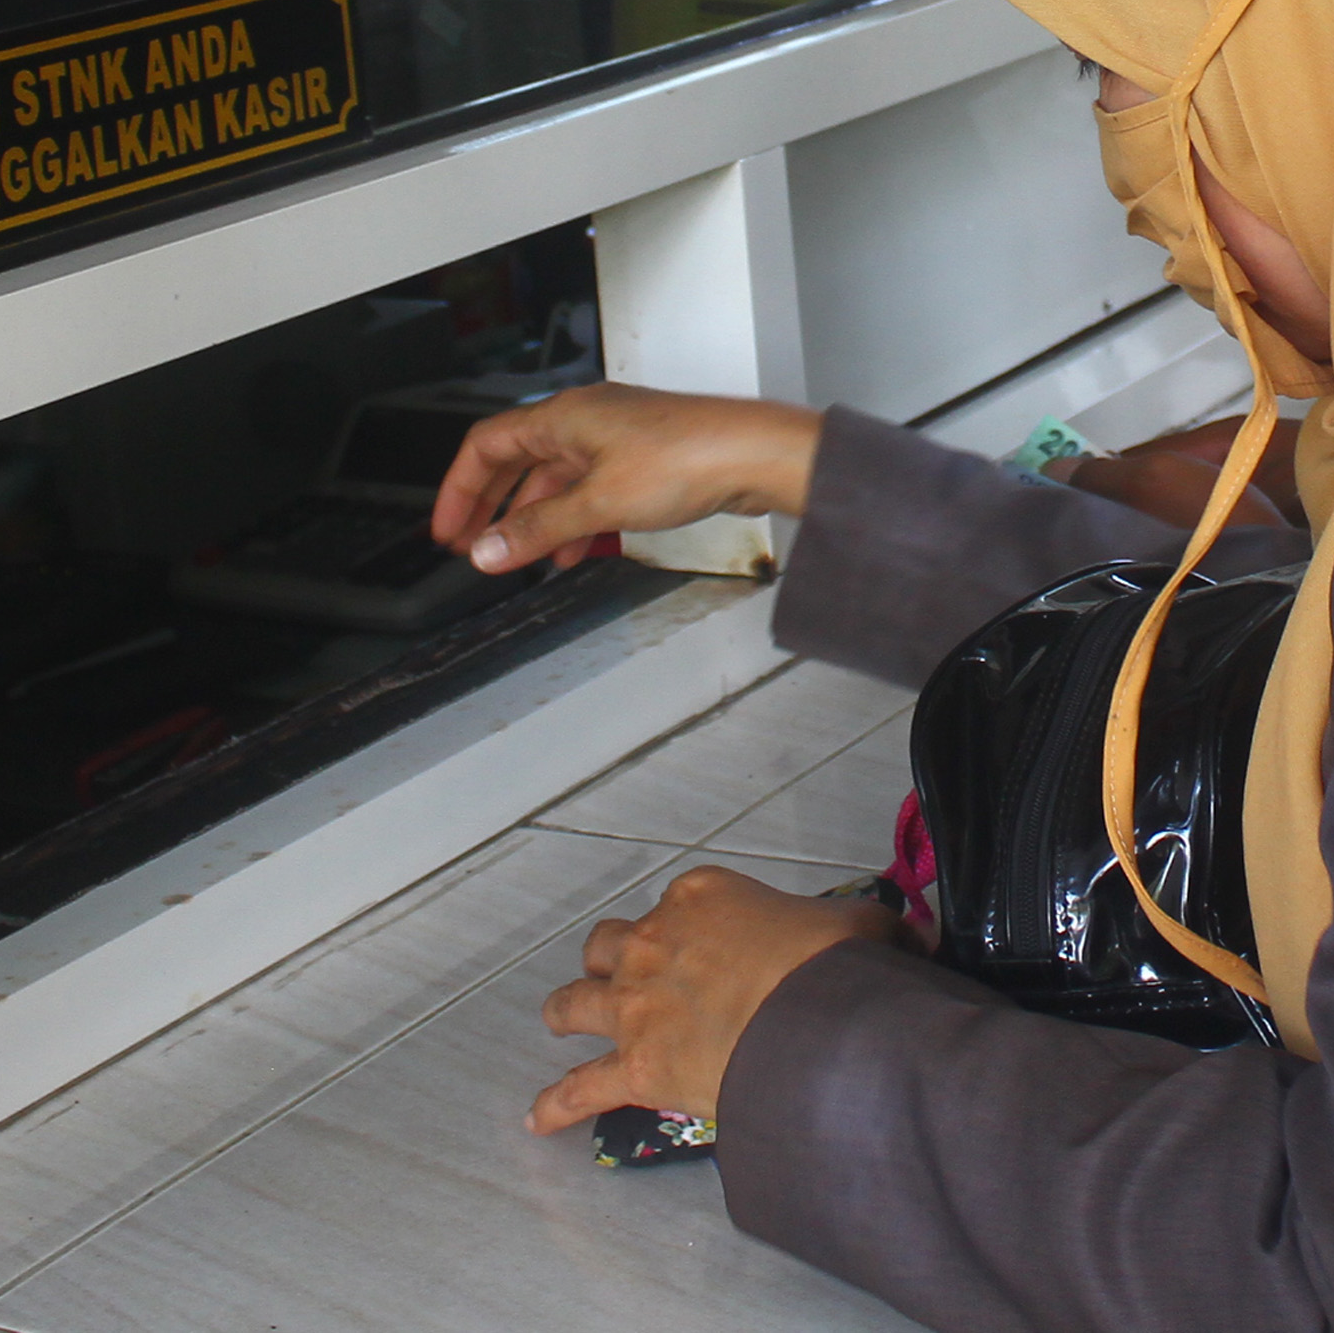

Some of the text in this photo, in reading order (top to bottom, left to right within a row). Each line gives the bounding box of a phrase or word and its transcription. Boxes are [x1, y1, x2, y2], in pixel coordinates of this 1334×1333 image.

[11, 50, 135, 127] STNK
[143, 17, 257, 96] ANDA
[216, 67, 332, 143] KASIR
